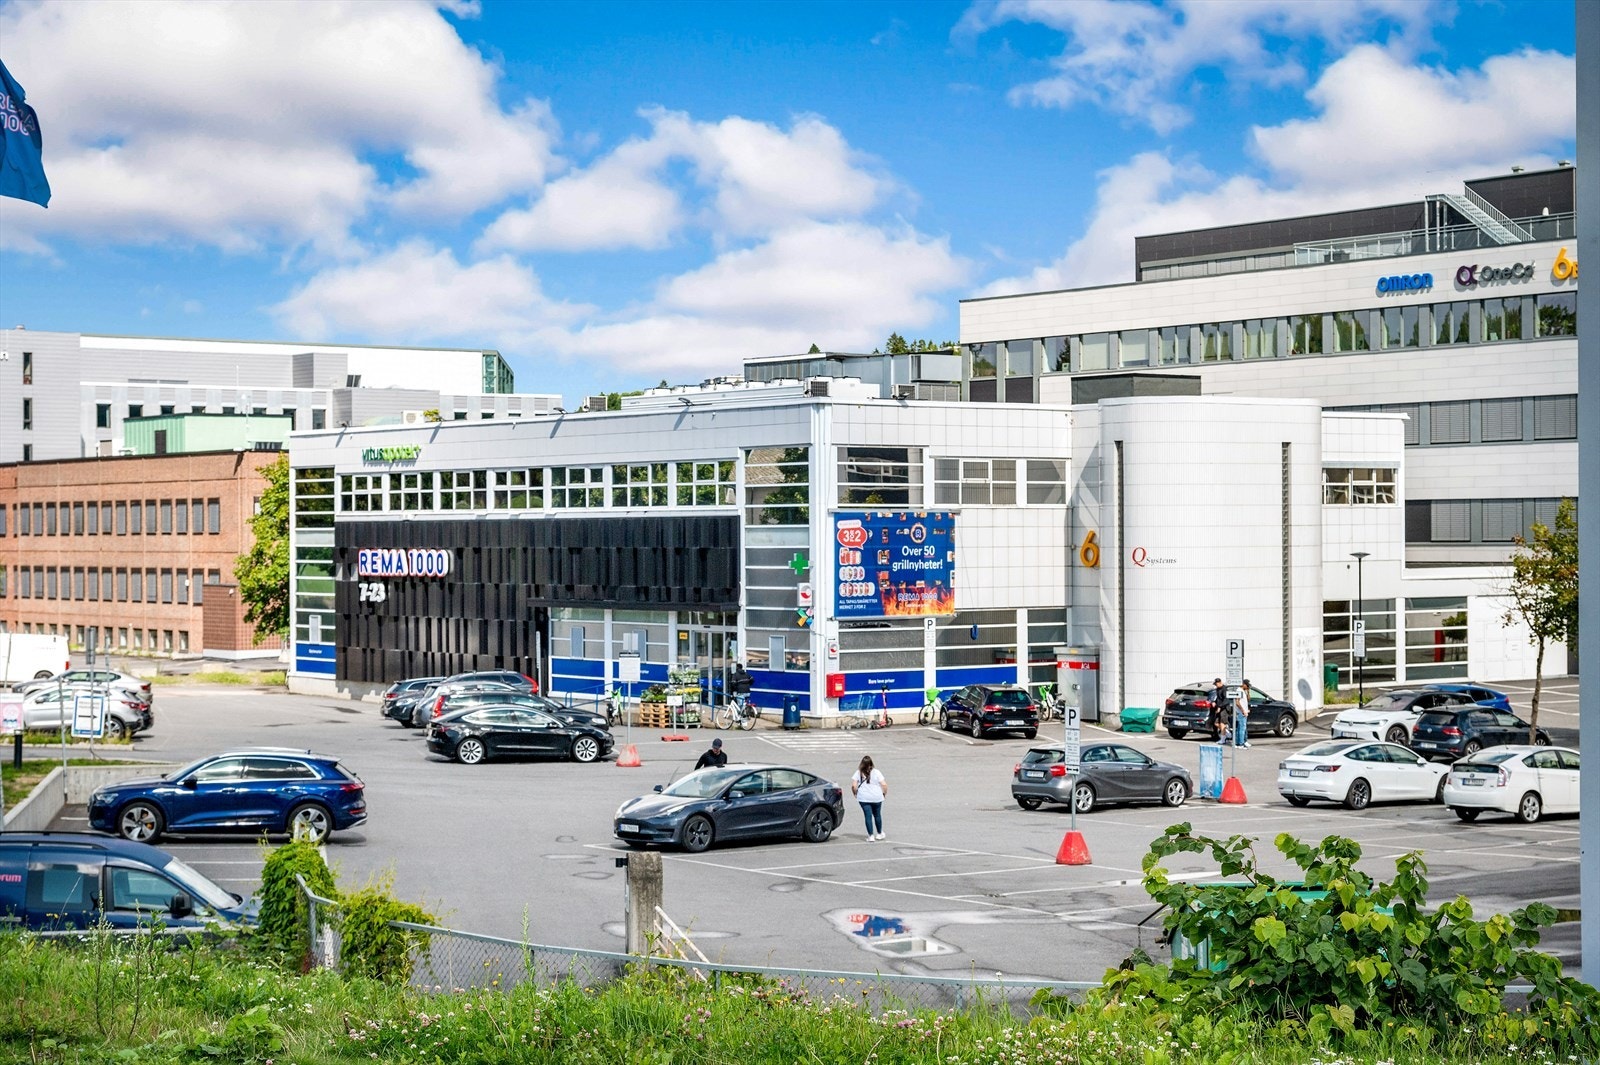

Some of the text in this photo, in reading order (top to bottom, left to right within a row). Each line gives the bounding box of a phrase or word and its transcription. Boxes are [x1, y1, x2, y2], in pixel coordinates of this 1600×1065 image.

[1377, 273, 1433, 292] OMRON
[843, 530, 850, 542] 3
[855, 530, 861, 542] 2
[901, 545, 936, 556] Over 50
[1080, 529, 1100, 568] 6
[358, 549, 448, 577] REMA 1000
[1131, 547, 1147, 567] Q
[892, 559, 943, 571] grillnyheter!
[359, 583, 386, 602] 7-23
[927, 619, 933, 630] P
[1357, 622, 1362, 633] P
[1230, 641, 1239, 655] P
[1068, 709, 1077, 726] P
